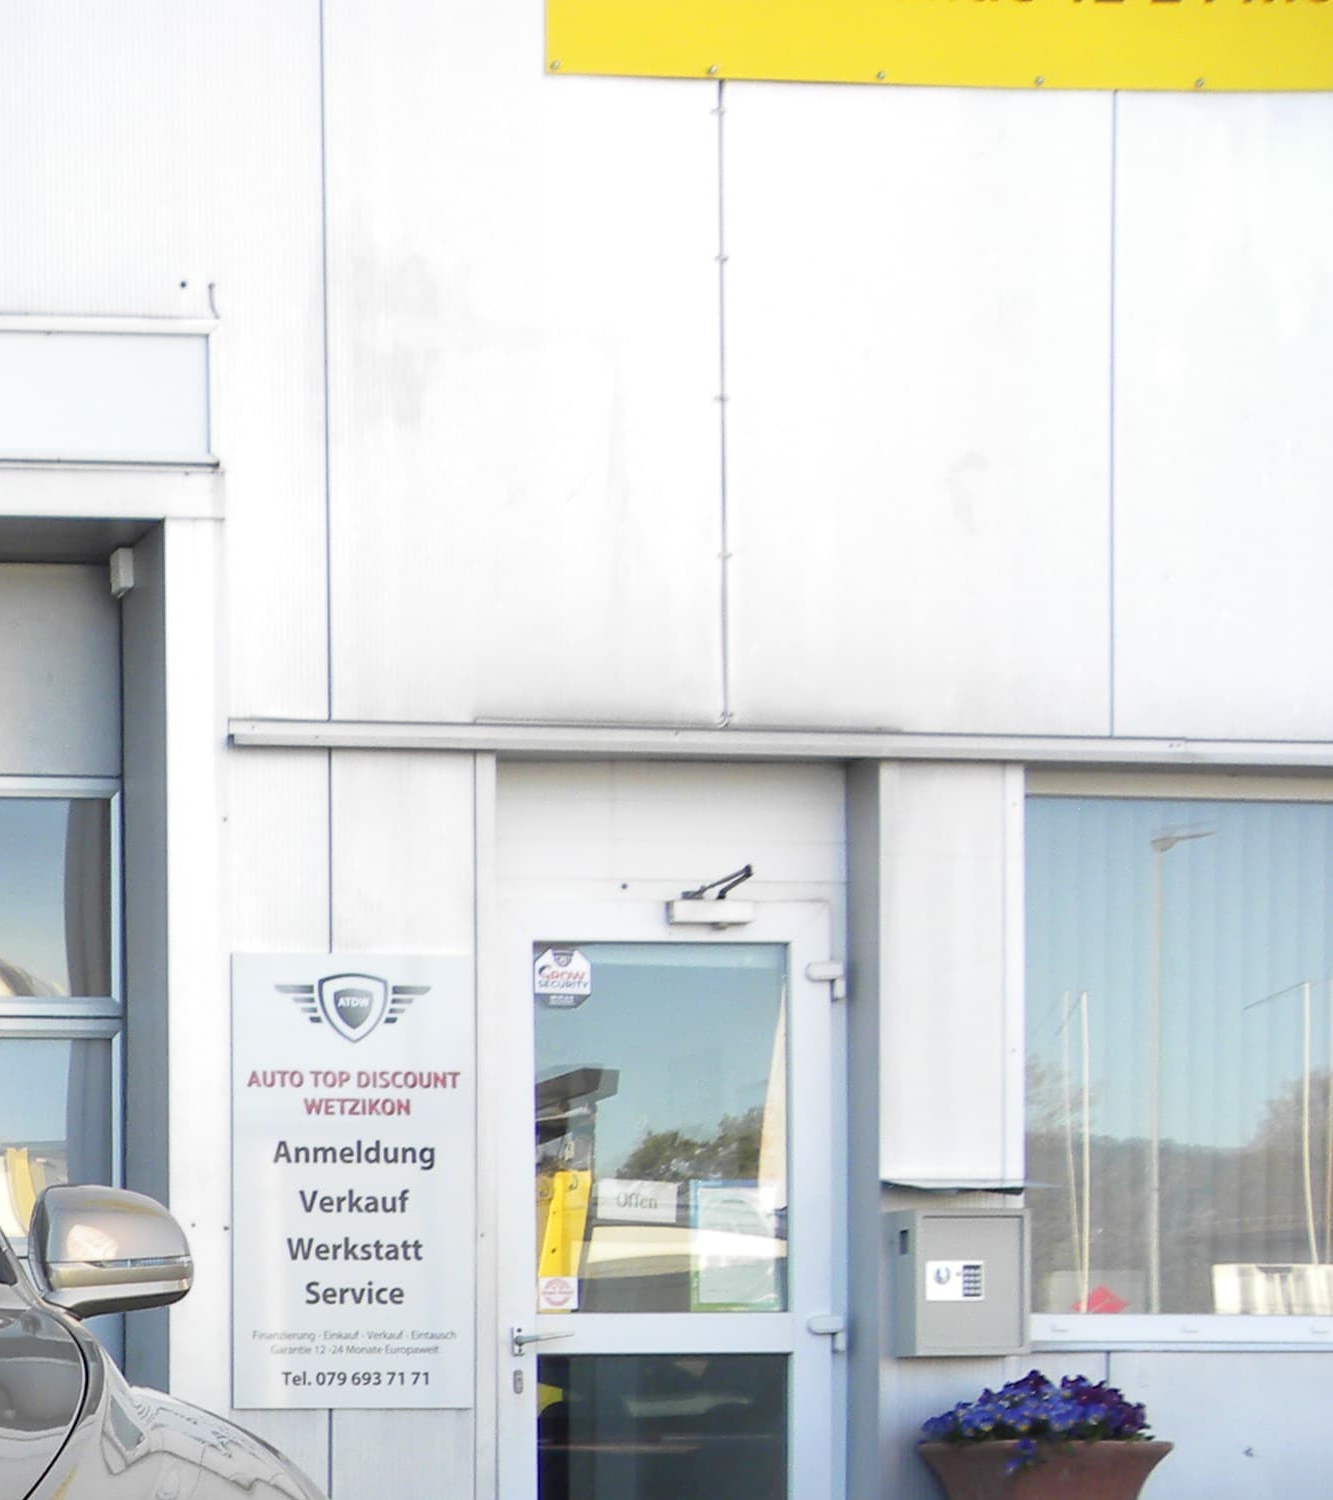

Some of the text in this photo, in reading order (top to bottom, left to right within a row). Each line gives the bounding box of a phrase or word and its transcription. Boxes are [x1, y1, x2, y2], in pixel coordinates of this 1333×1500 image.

[247, 1070, 461, 1089] AUTO TOP DISCOUNT
[304, 1098, 411, 1116] WETZIKON
[273, 1140, 436, 1171] Anmeldung
[299, 1188, 410, 1214] Verkauf
[615, 1191, 658, 1210] Offen
[286, 1237, 424, 1261] Werkstatt
[305, 1281, 405, 1305] Service
[252, 1330, 457, 1343] Finanzierung Einkauf Verkauf Eintausch
[270, 1344, 312, 1355] Garantie
[314, 1345, 326, 1355] 12
[345, 1345, 382, 1355] Monate
[384, 1344, 440, 1357] Europaweit
[281, 1371, 430, 1386] Tel. 079 693 71 71
